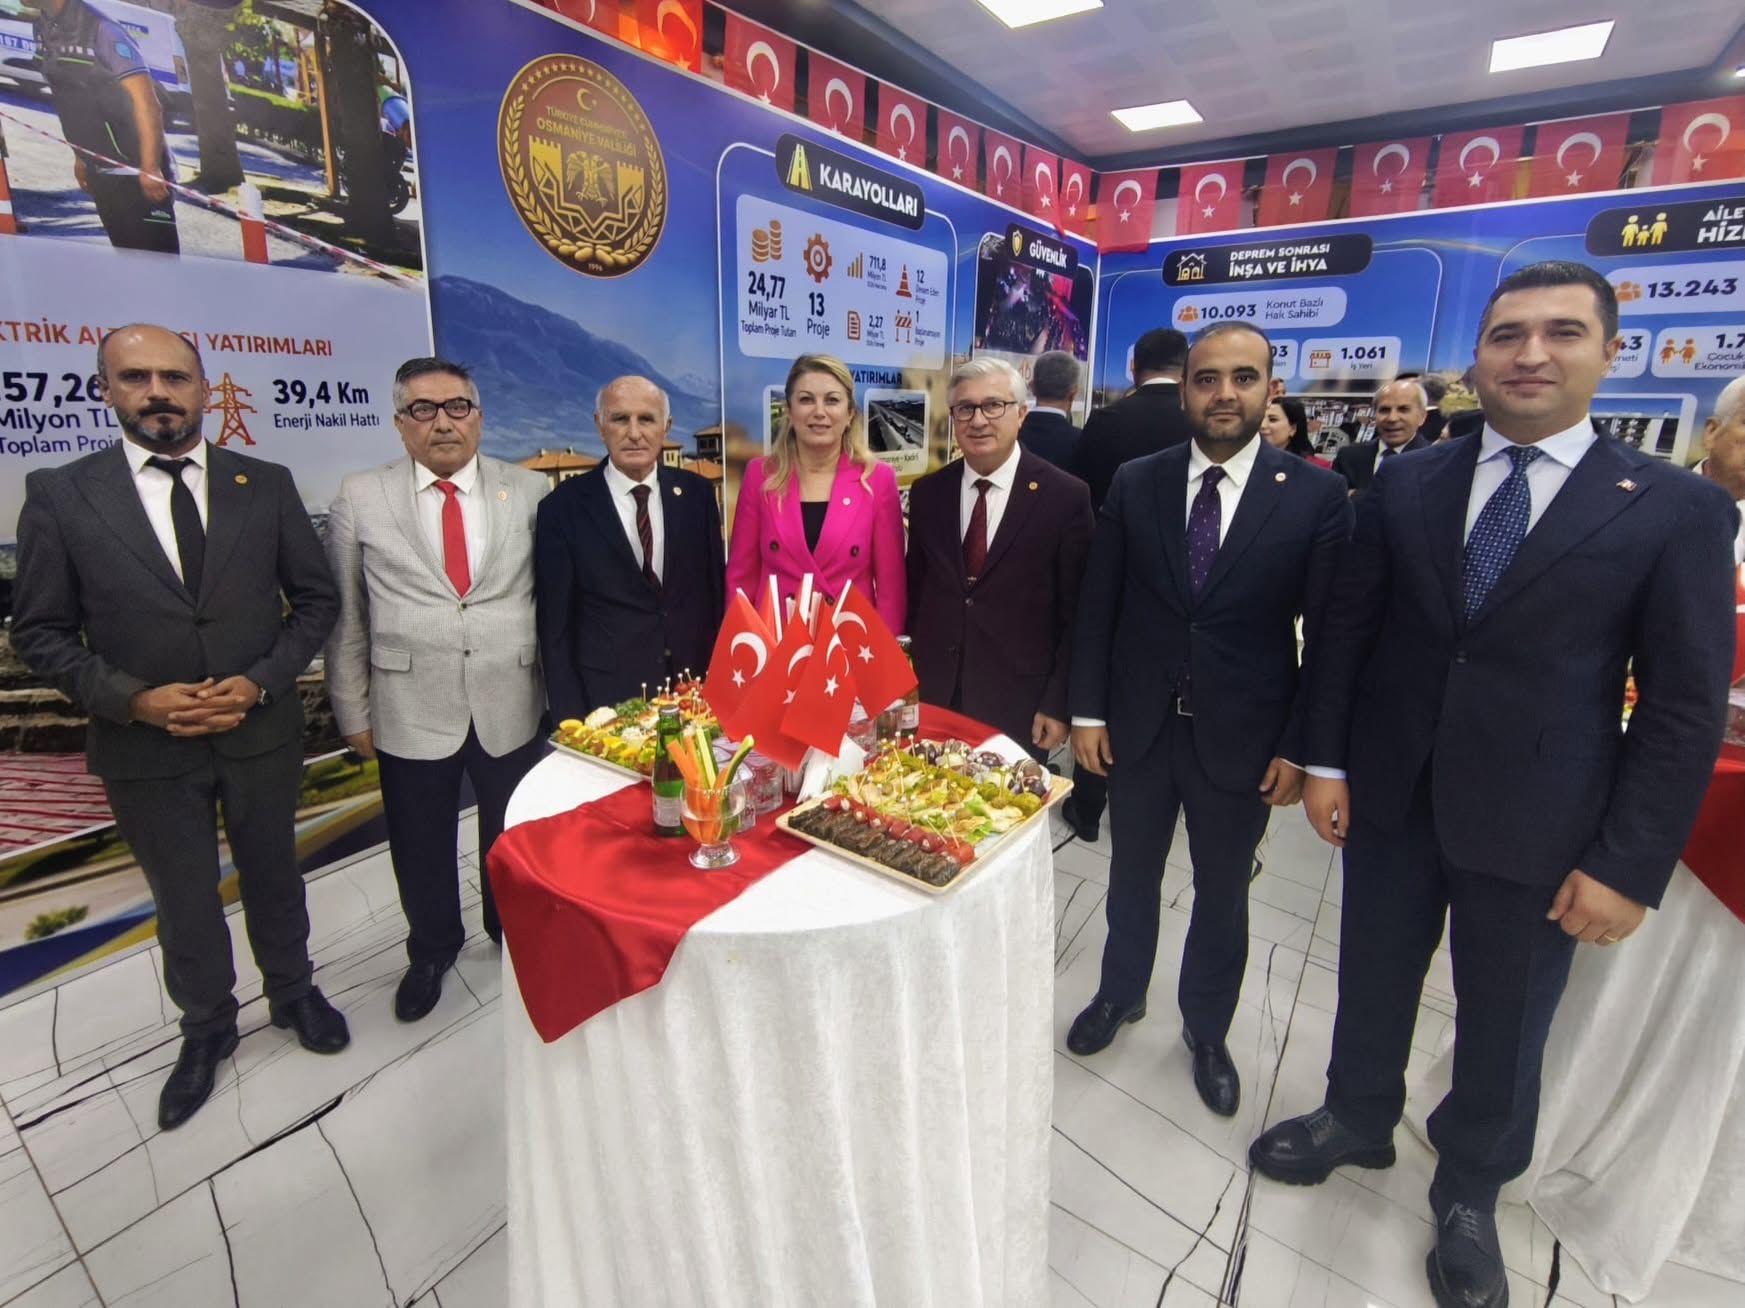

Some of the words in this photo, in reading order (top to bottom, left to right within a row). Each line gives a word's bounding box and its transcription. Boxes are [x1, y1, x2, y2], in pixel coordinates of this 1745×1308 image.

[536, 116, 596, 145] OSMANİYE
[820, 163, 917, 216] KARAYOLLARI
[1703, 204, 1745, 222] AİLE
[1697, 221, 1745, 243] HİZ
[1029, 239, 1068, 269] GÜVENLİK
[1230, 249, 1275, 261] DEPREM
[1278, 244, 1330, 257] SONRASI
[916, 269, 925, 284] 12
[1229, 262, 1263, 278] İNŞA
[1266, 261, 1287, 274] VE
[1290, 256, 1328, 272] İHYA
[748, 270, 786, 302] 24,77
[1648, 278, 1738, 299] 13.243
[748, 300, 778, 321] Milyar
[779, 304, 791, 321] TL
[808, 291, 826, 318] 13
[1201, 303, 1257, 320] 10.093
[806, 318, 831, 340] Proje
[205, 332, 334, 357] YATIRIMLARI
[1340, 345, 1387, 360] 1.061
[0, 371, 104, 408] 57,26
[272, 379, 331, 408] 39,4
[338, 381, 369, 404] Km
[0, 407, 81, 434] Milyon
[87, 408, 119, 428] TL
[273, 412, 313, 430] Enerji
[315, 412, 347, 427] Nakil
[350, 414, 380, 427] Hattı
